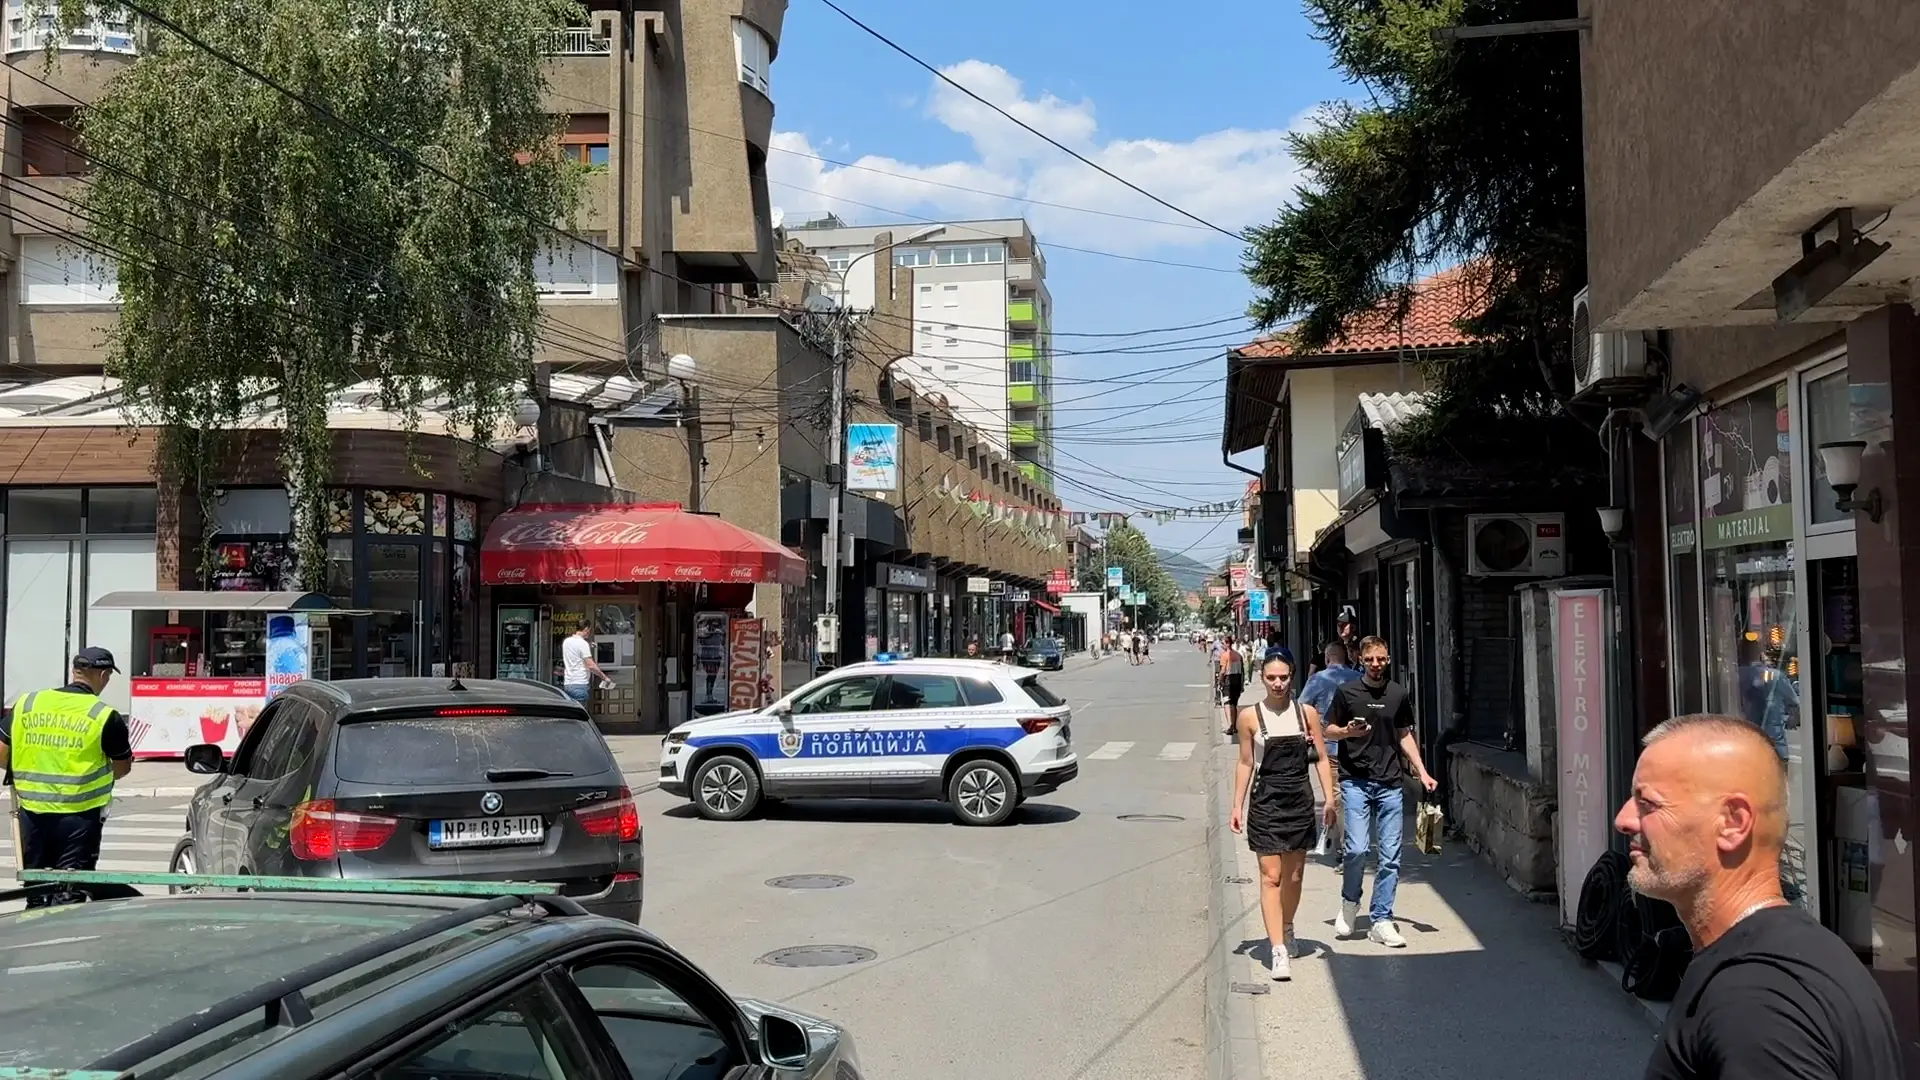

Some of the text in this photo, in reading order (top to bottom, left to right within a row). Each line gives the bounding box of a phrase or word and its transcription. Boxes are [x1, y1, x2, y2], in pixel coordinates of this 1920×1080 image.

[1671, 515, 1770, 548] ELEKTRO MATERIJAL
[1572, 602, 1588, 732] ELEKTRO
[21, 713, 91, 735] САОБРАЋАЈНА
[25, 732, 83, 748] ПОЛИЦИЈА
[812, 732, 925, 741] САОБРАЋАЈНА
[812, 741, 926, 755] ПОЛИЦИЈА
[575, 791, 608, 801] X3
[445, 822, 466, 840] NP
